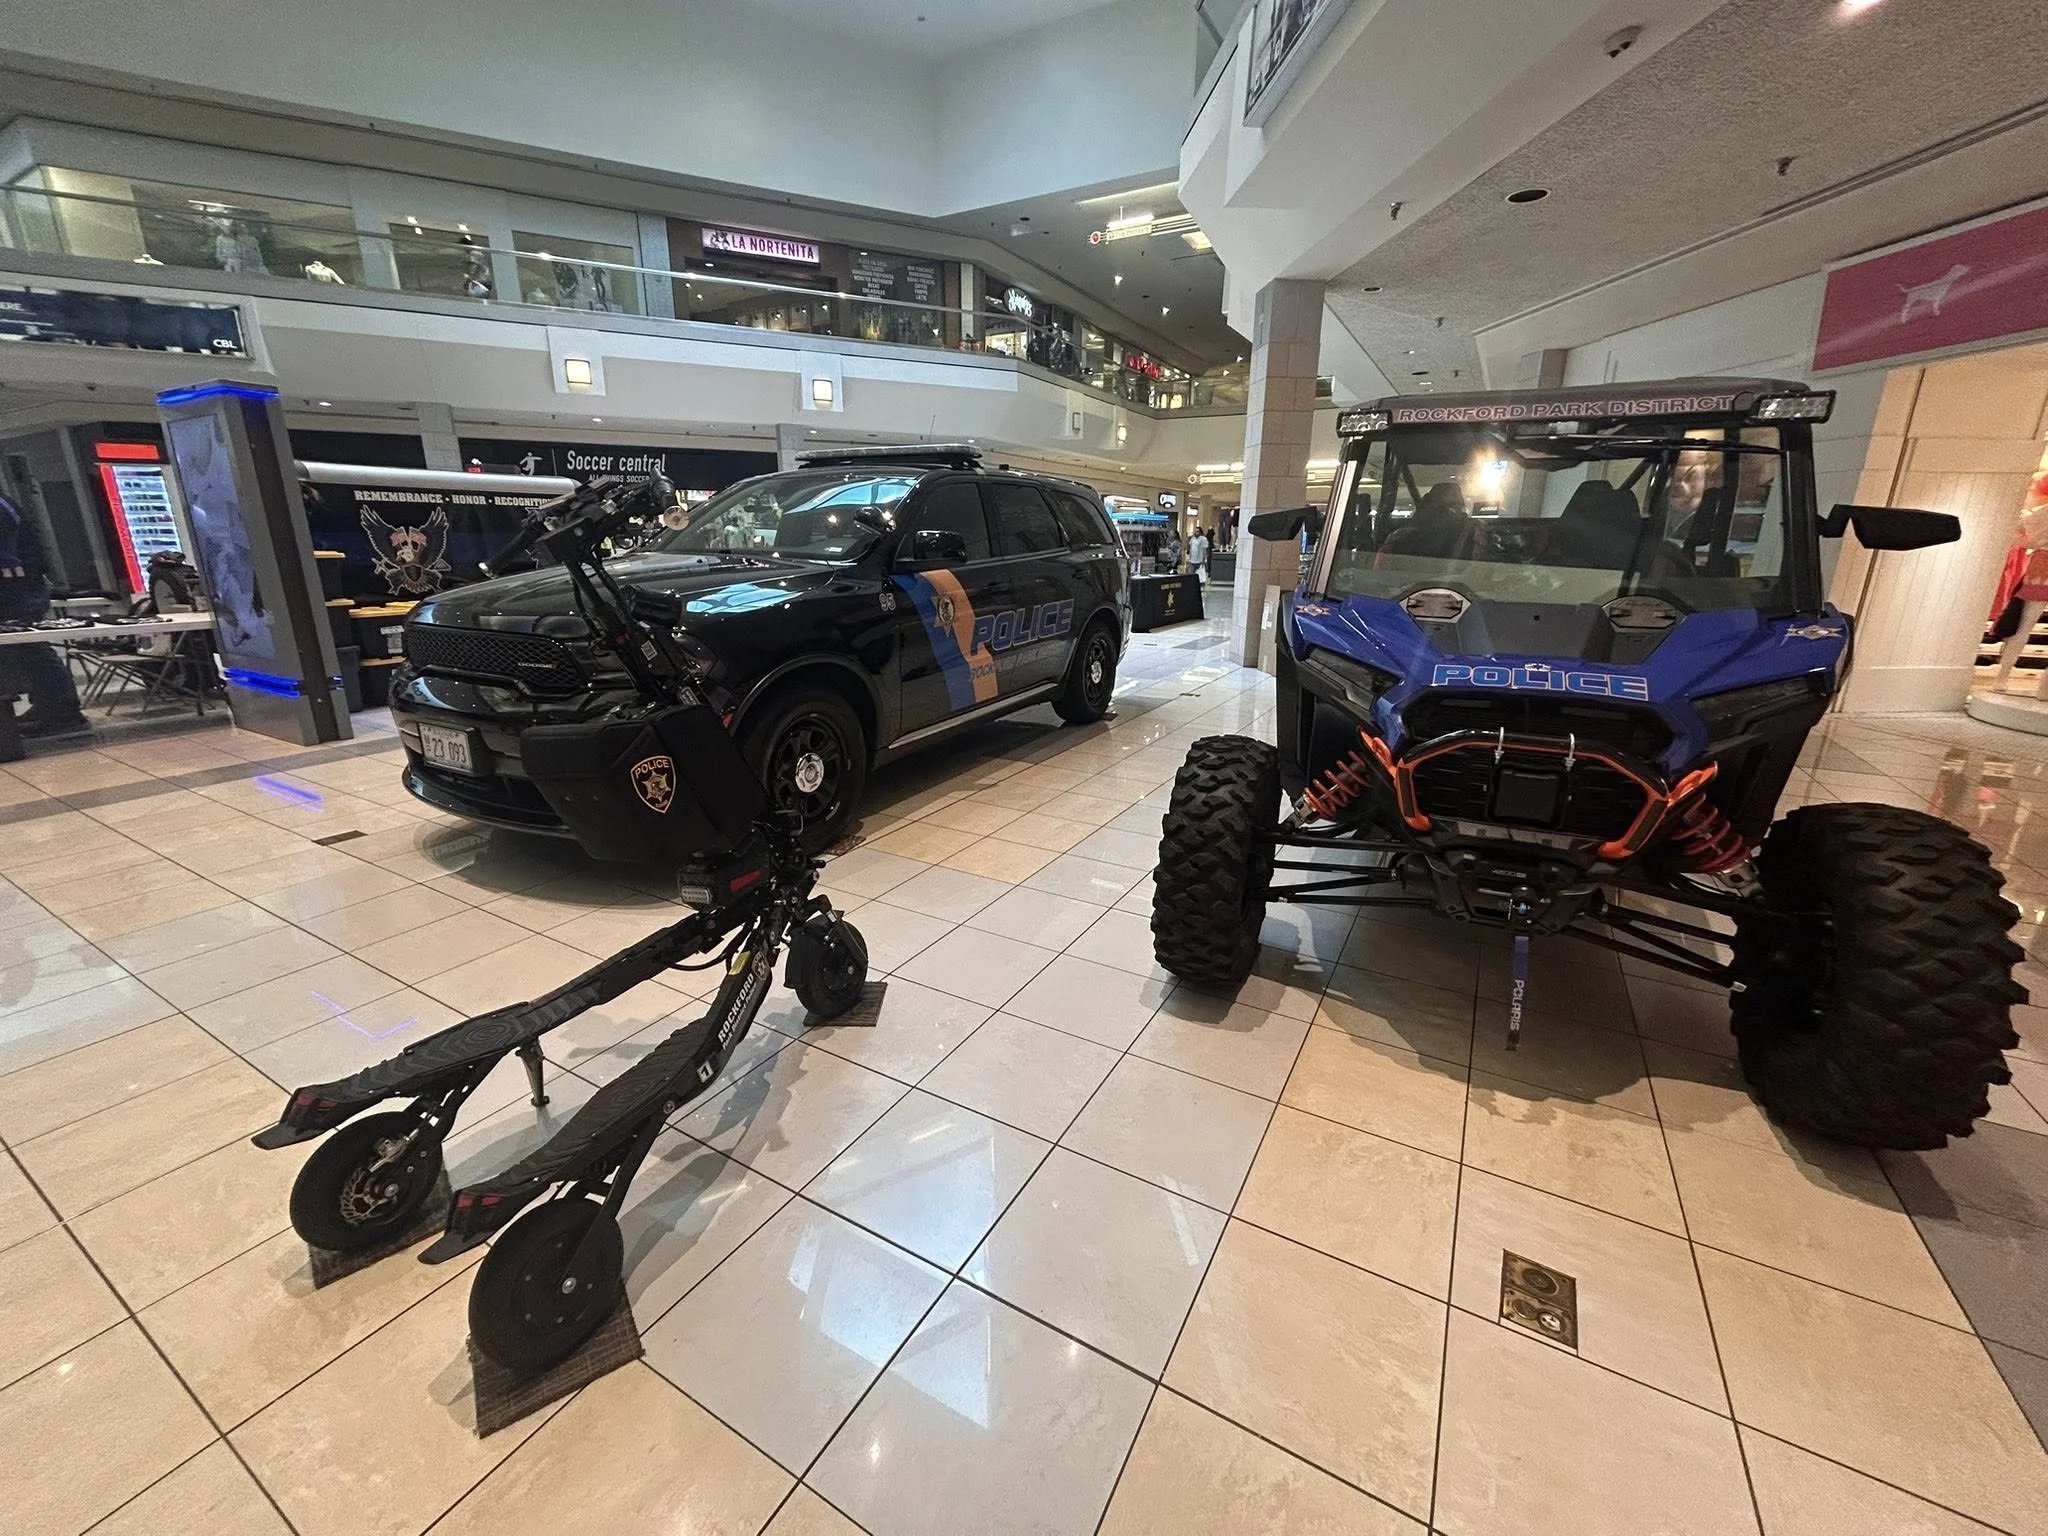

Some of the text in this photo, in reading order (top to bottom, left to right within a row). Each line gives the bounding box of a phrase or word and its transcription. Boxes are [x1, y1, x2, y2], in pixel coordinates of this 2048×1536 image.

[732, 235, 814, 260] LA NORTENITA
[213, 338, 237, 349] CBL
[1397, 395, 1736, 423] ROCKFORD PARK DISTRICT
[567, 450, 666, 472] Soccer central
[354, 490, 551, 506] REMEMBRANCE HONOR RECOGNITIO
[879, 593, 896, 611] 95
[970, 599, 1075, 657] POLICE
[1431, 664, 1649, 702] POLICE
[634, 759, 671, 779] POLICE
[718, 973, 754, 1042] ROCKFORD
[1509, 978, 1525, 1031] POLARIS
